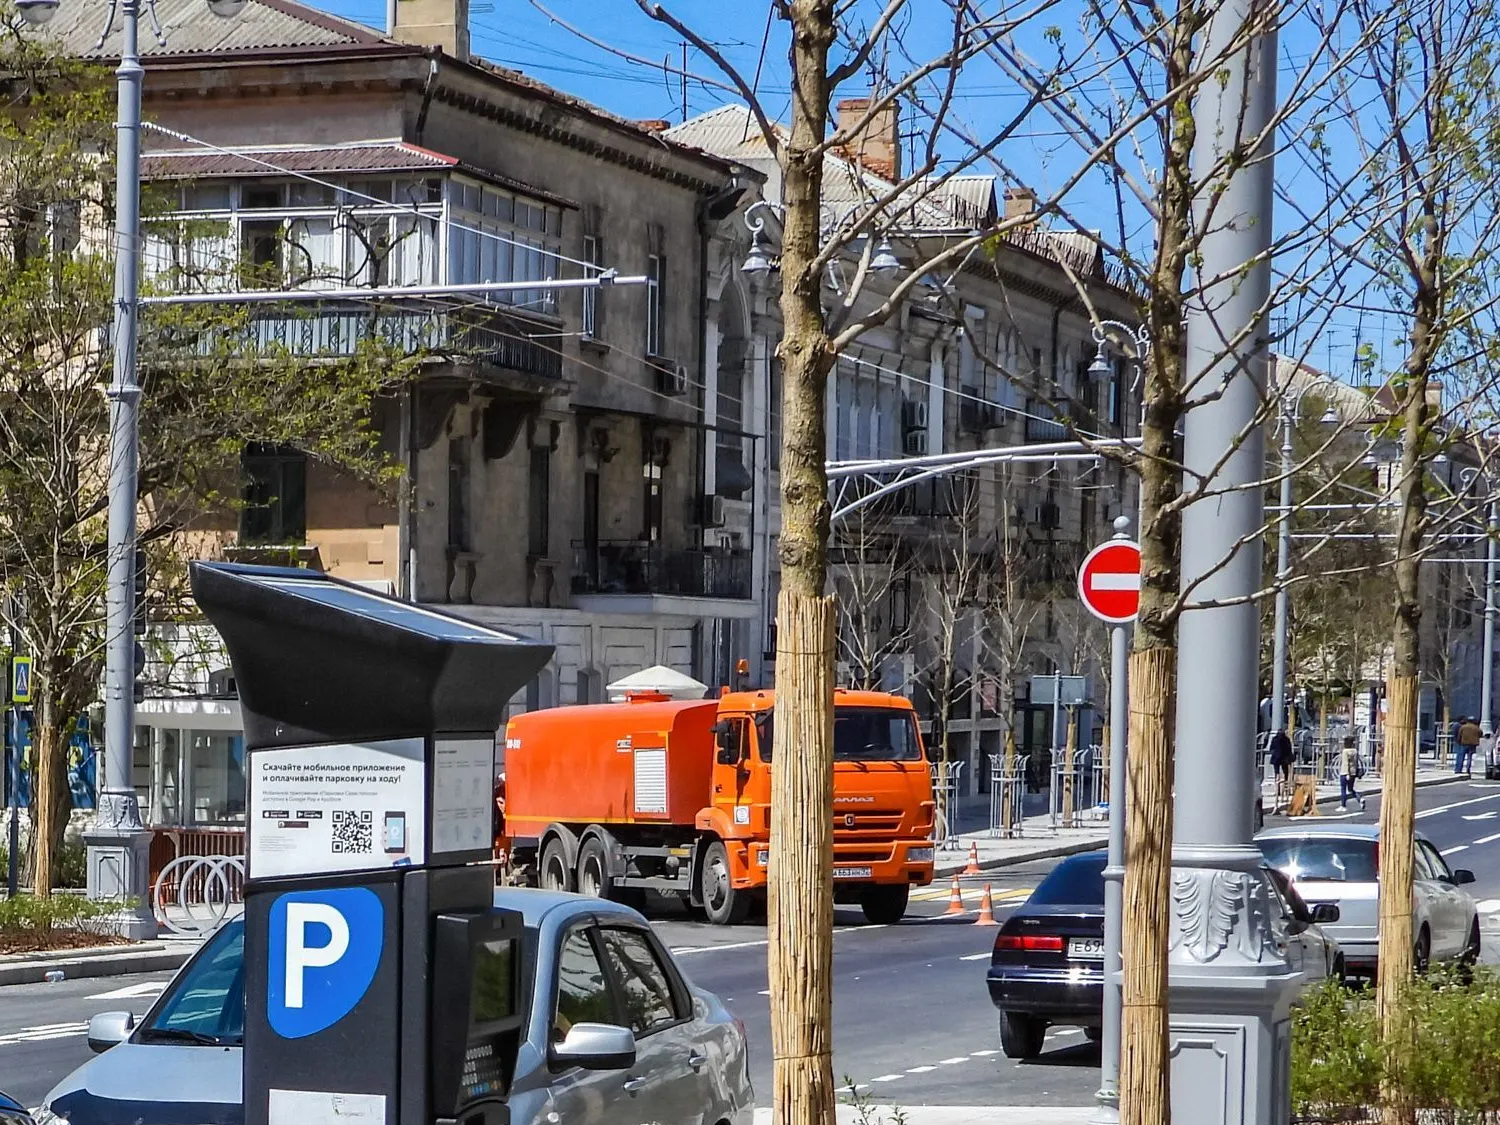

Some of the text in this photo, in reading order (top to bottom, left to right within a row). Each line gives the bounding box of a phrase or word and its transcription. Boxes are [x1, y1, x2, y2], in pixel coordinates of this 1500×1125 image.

[262, 763, 406, 773] Скачайте мобильное приложение
[269, 775, 324, 783] оплачивайте
[325, 776, 365, 784] парковку
[379, 775, 401, 784] ходу!
[285, 902, 350, 1008] P
